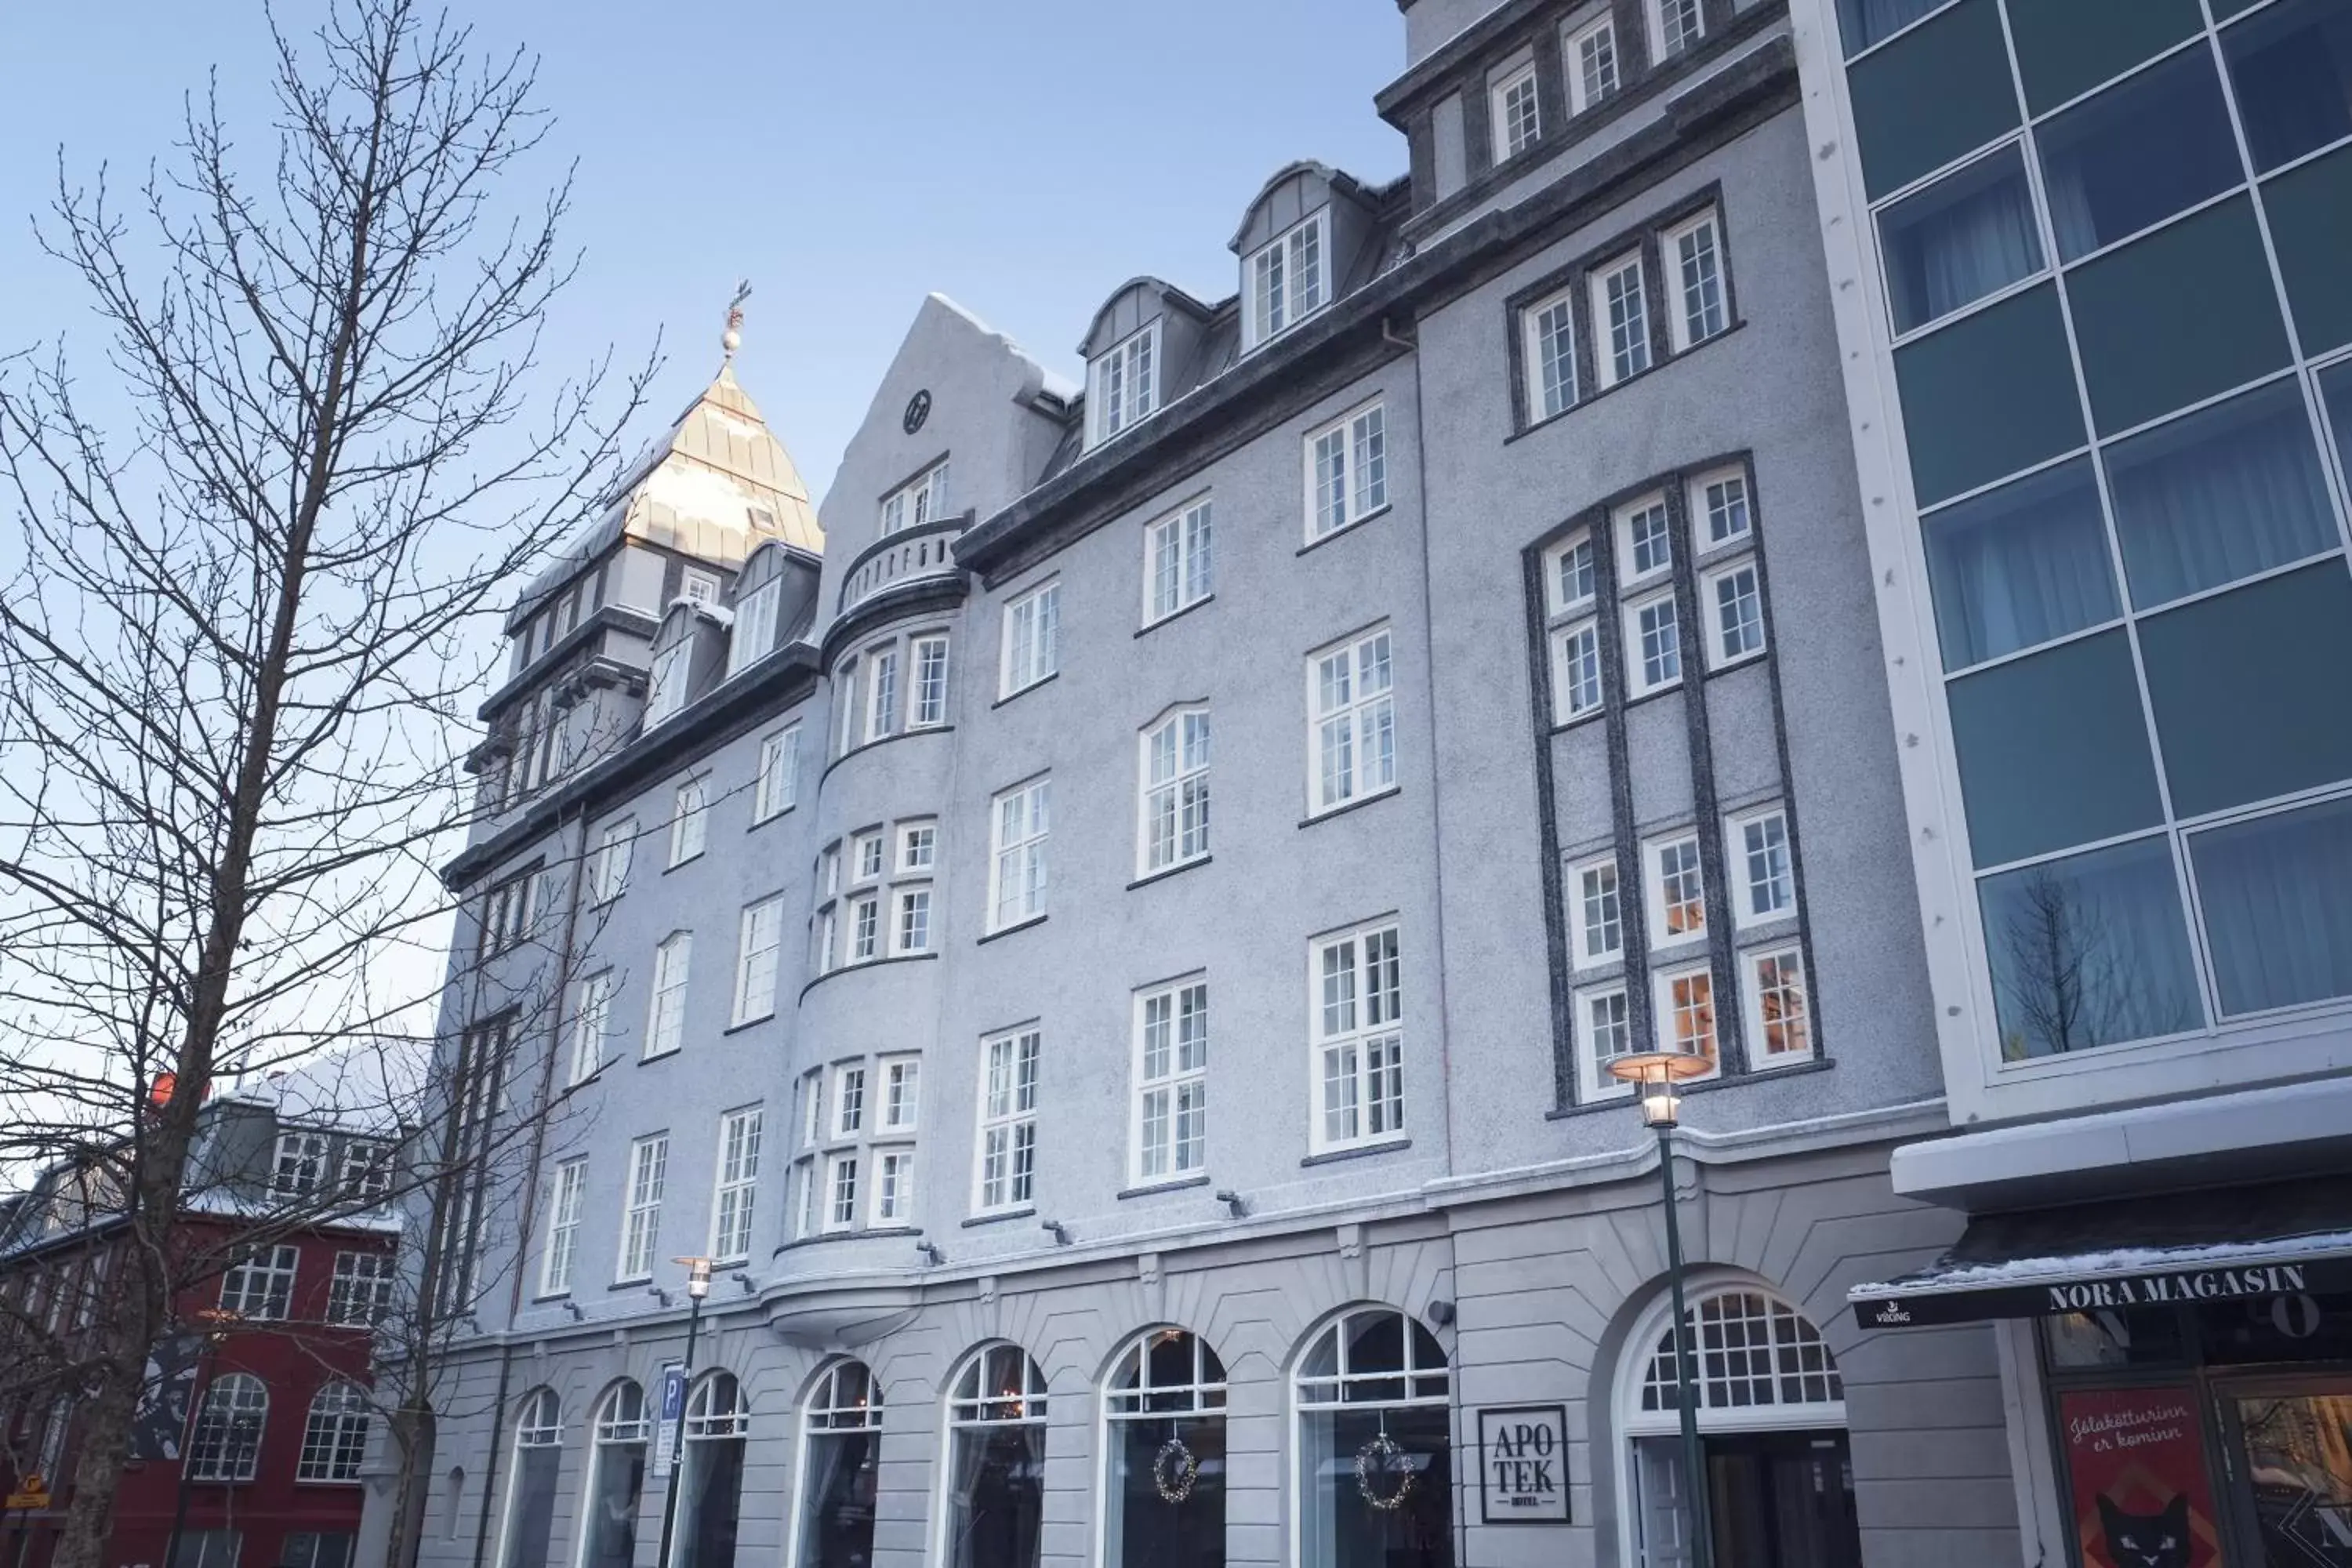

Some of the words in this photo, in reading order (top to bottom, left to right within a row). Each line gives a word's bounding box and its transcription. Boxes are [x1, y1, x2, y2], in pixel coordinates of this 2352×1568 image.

[2049, 1280, 2136, 1310] NORA
[2143, 1265, 2305, 1302] MAGASIN
[666, 1379, 677, 1410] P
[1493, 1423, 1553, 1457] APO
[1493, 1460, 1555, 1494] TEK
